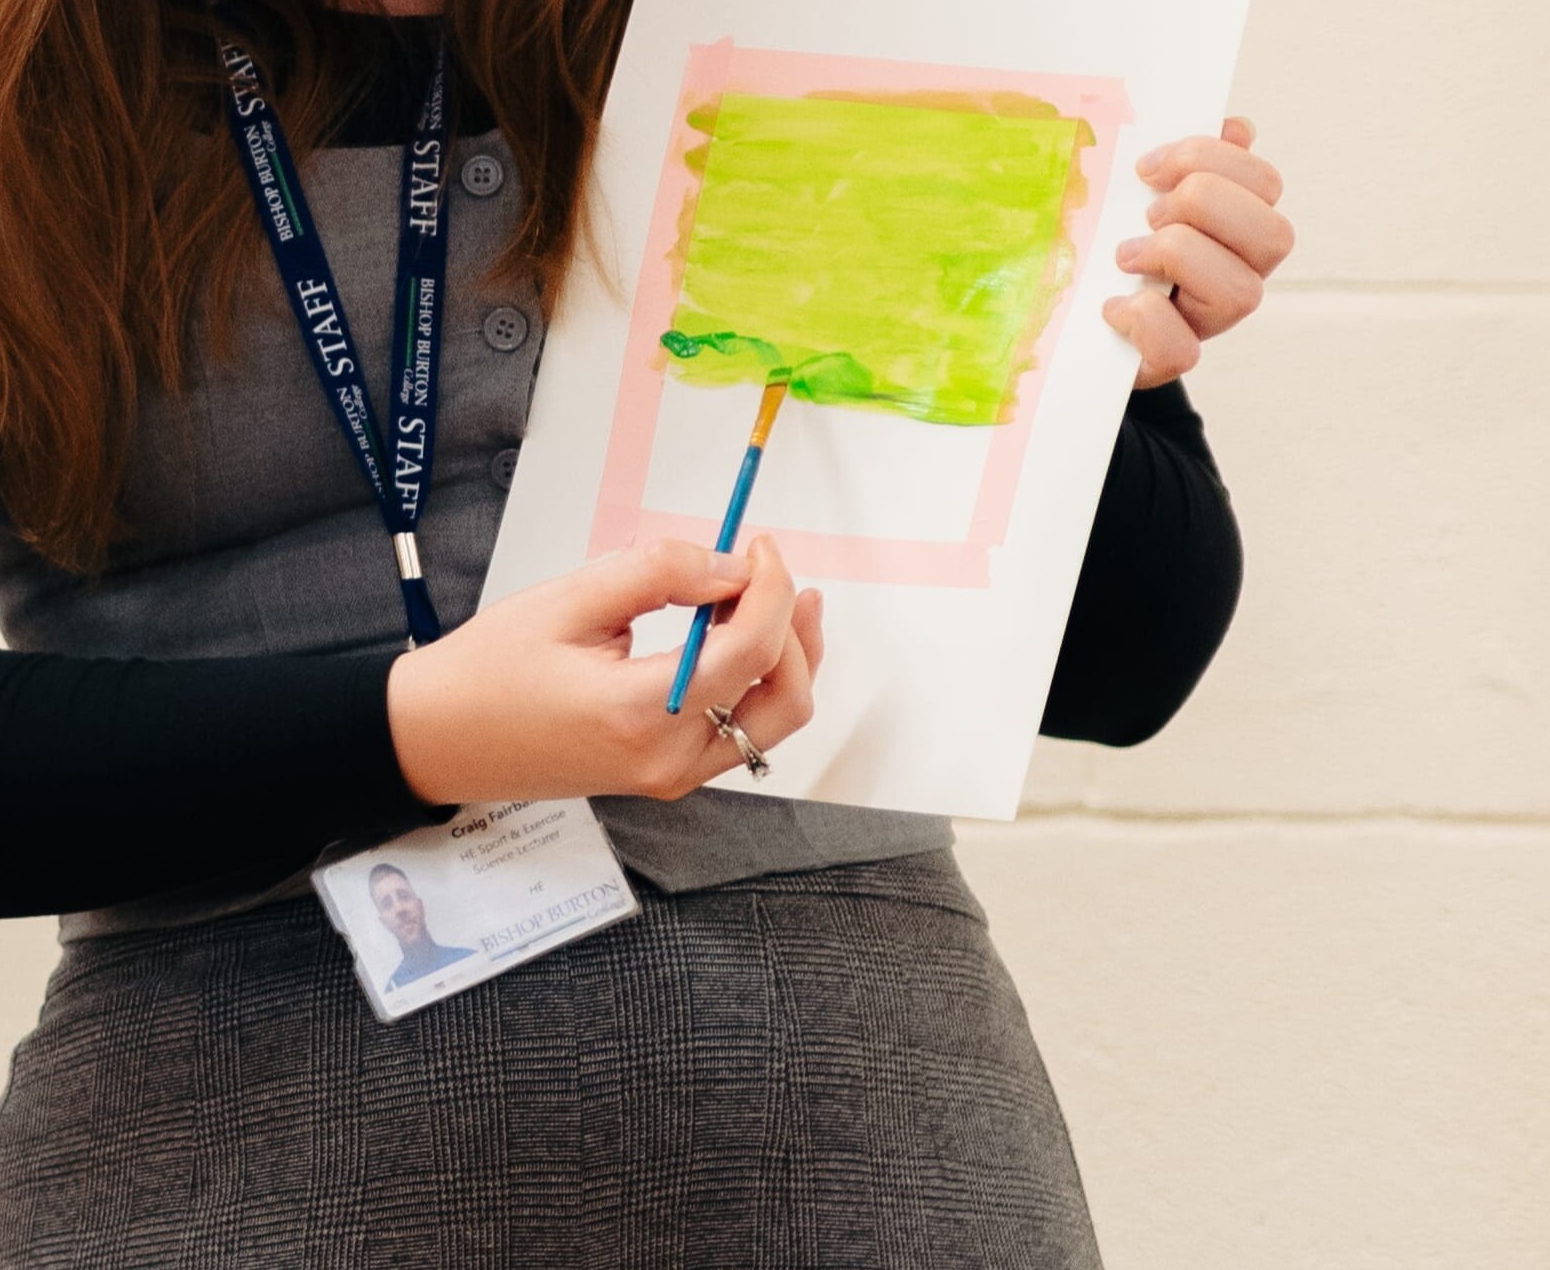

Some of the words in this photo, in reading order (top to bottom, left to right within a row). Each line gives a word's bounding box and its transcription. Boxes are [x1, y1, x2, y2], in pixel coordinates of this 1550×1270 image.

[221, 43, 265, 116] STAF
[244, 124, 275, 185] BURTON
[264, 187, 294, 242] BISHOP
[410, 140, 441, 237] STAFF
[297, 279, 354, 376] STAFF
[418, 277, 435, 337] BISHOP
[399, 367, 414, 405] College
[414, 339, 431, 407] BURTON
[337, 386, 370, 450] BURTON
[451, 818, 488, 839] Craig
[460, 849, 477, 863] HE
[478, 834, 507, 855] Sport
[510, 829, 520, 840] &
[522, 810, 566, 835] Exercise
[472, 850, 515, 875] Science
[516, 830, 561, 857] Lecturer
[480, 913, 543, 953] BISHOP
[547, 878, 621, 923] BURTON
[529, 880, 545, 896] HE
